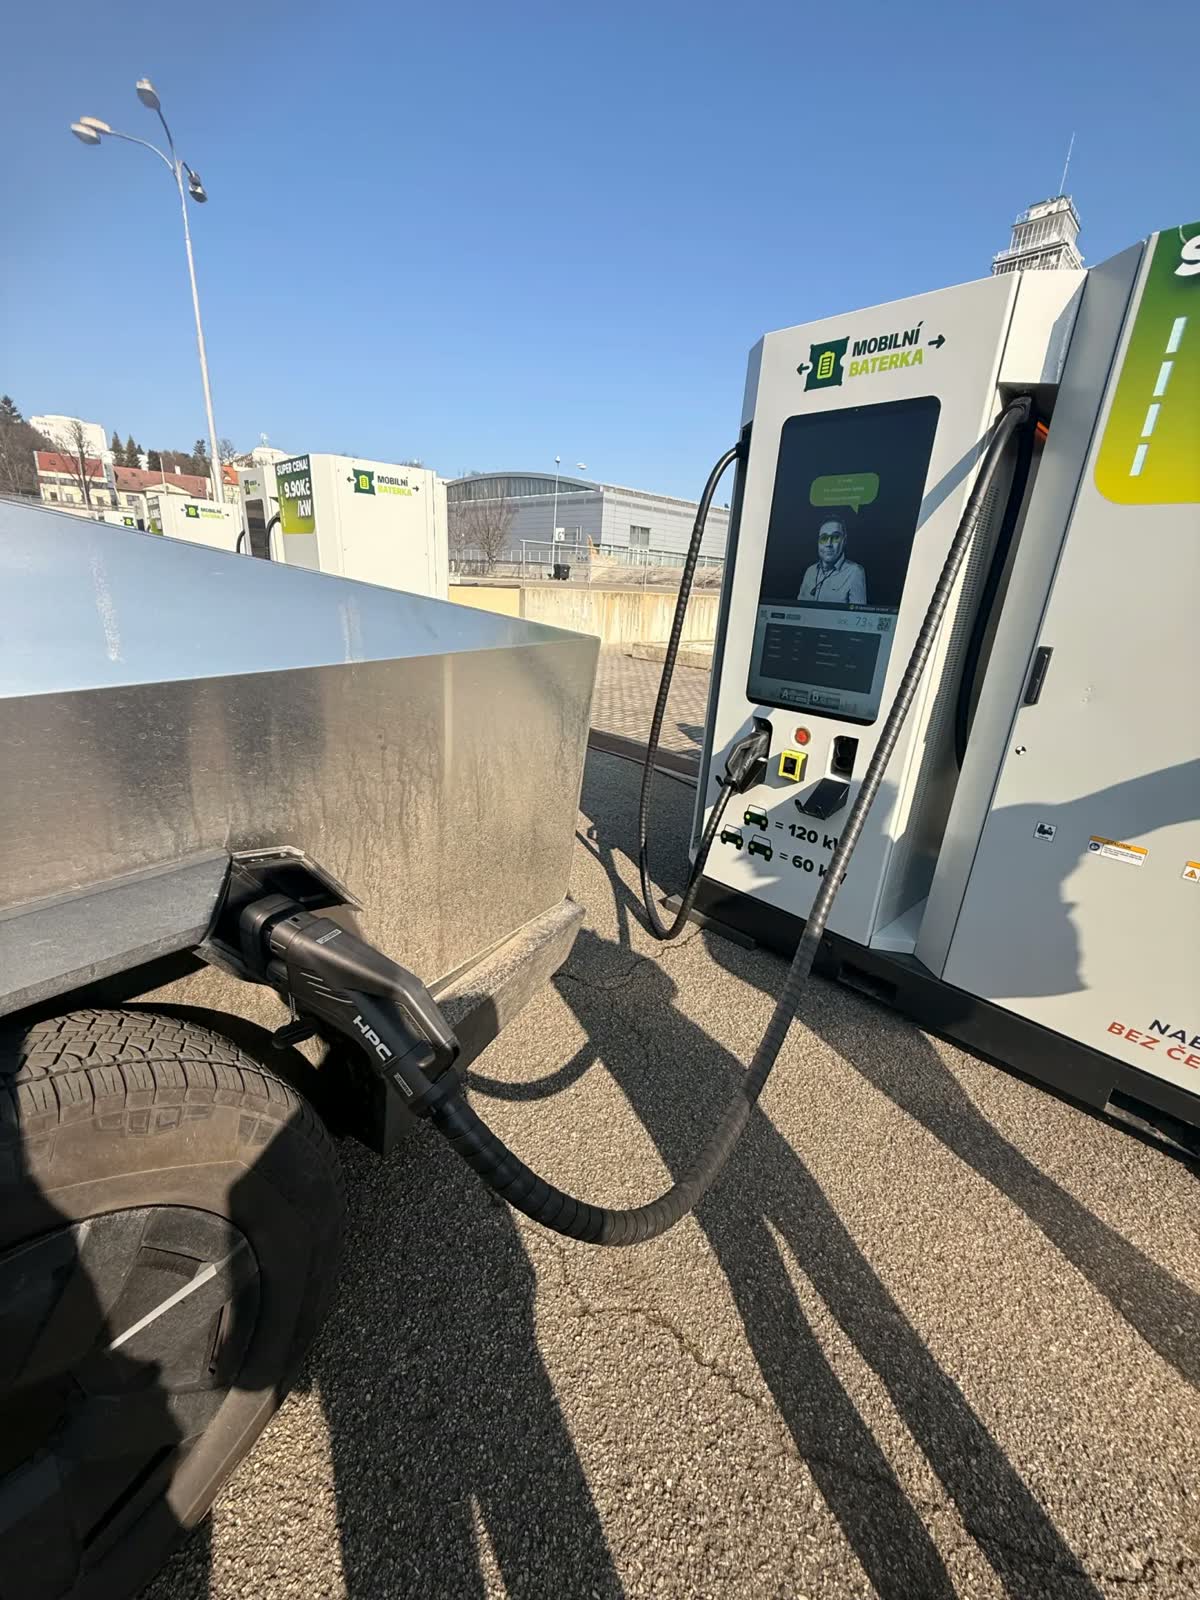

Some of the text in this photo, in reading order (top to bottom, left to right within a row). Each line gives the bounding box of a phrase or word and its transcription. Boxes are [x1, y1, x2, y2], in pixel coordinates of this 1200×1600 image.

[852, 320, 924, 357] MOBILNÍ
[848, 348, 923, 377] BATERKA
[277, 462, 292, 475] SUPER
[377, 475, 409, 487] MOBILNÍ
[377, 484, 413, 496] BATERKA
[788, 823, 818, 843] 120
[792, 855, 814, 872] 60
[353, 1014, 393, 1061] HPC
[1107, 1022, 1160, 1050] BEZ
